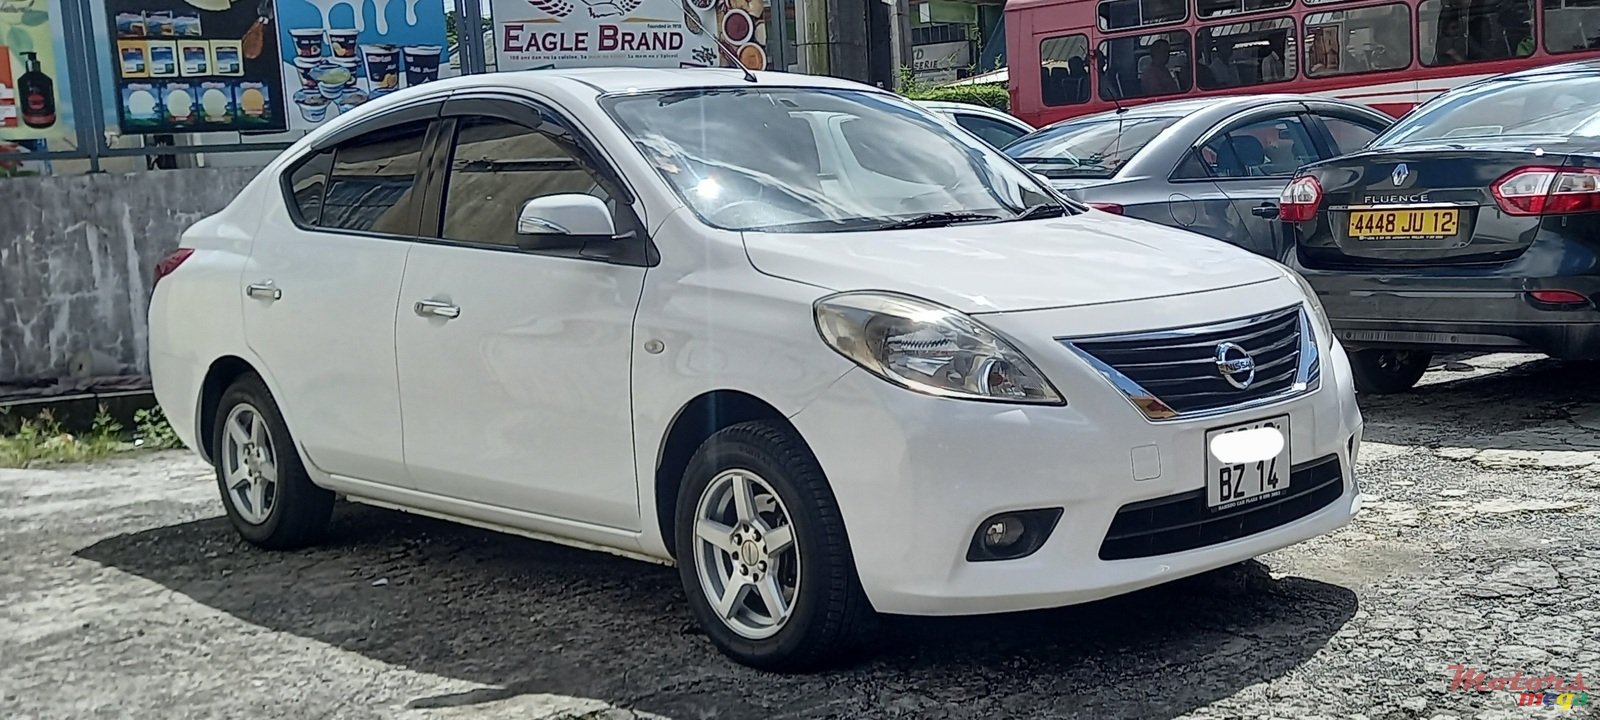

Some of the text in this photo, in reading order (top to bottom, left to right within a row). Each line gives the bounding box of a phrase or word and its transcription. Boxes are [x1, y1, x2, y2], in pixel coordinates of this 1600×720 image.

[503, 24, 684, 53] EAGLE BRAND
[1364, 194, 1429, 204] FLUENCE
[1355, 211, 1453, 234] 4448 JU 12
[1220, 457, 1279, 502] BZ 14
